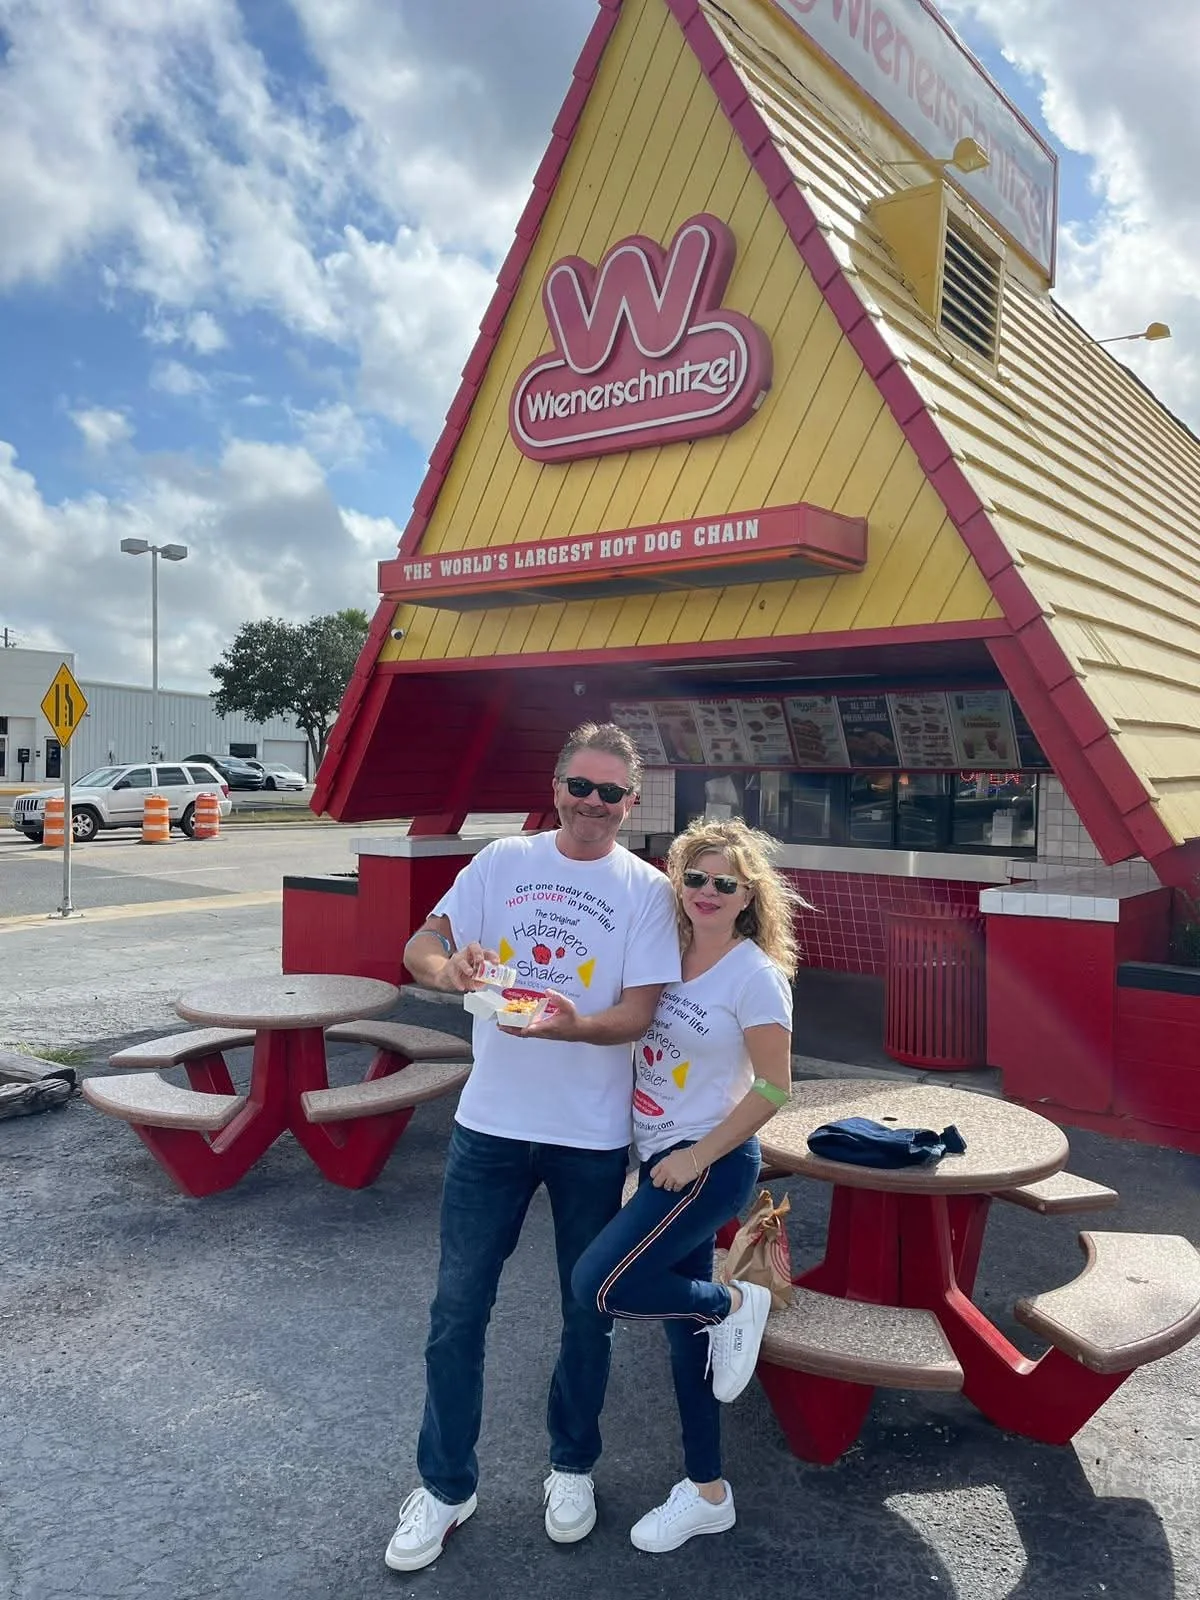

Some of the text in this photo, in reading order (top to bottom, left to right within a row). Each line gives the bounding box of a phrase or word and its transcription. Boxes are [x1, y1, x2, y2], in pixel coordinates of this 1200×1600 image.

[546, 224, 711, 375] W
[526, 350, 737, 422] Wienerschnitzel
[403, 519, 759, 581] THE WORLD'S LARGEST HOT DOG CHAIN
[515, 884, 532, 893] Get
[555, 884, 582, 898] today
[583, 891, 597, 903] for
[596, 898, 614, 915] that
[535, 909, 547, 919] The
[568, 898, 577, 906] in
[577, 903, 598, 917] your
[598, 914, 615, 933] life!
[512, 920, 588, 956] Habanero
[517, 960, 573, 985] Shaker
[662, 992, 707, 1018] today for that
[666, 1003, 674, 1012] in
[673, 1009, 690, 1020] your
[688, 1017, 710, 1036] life!
